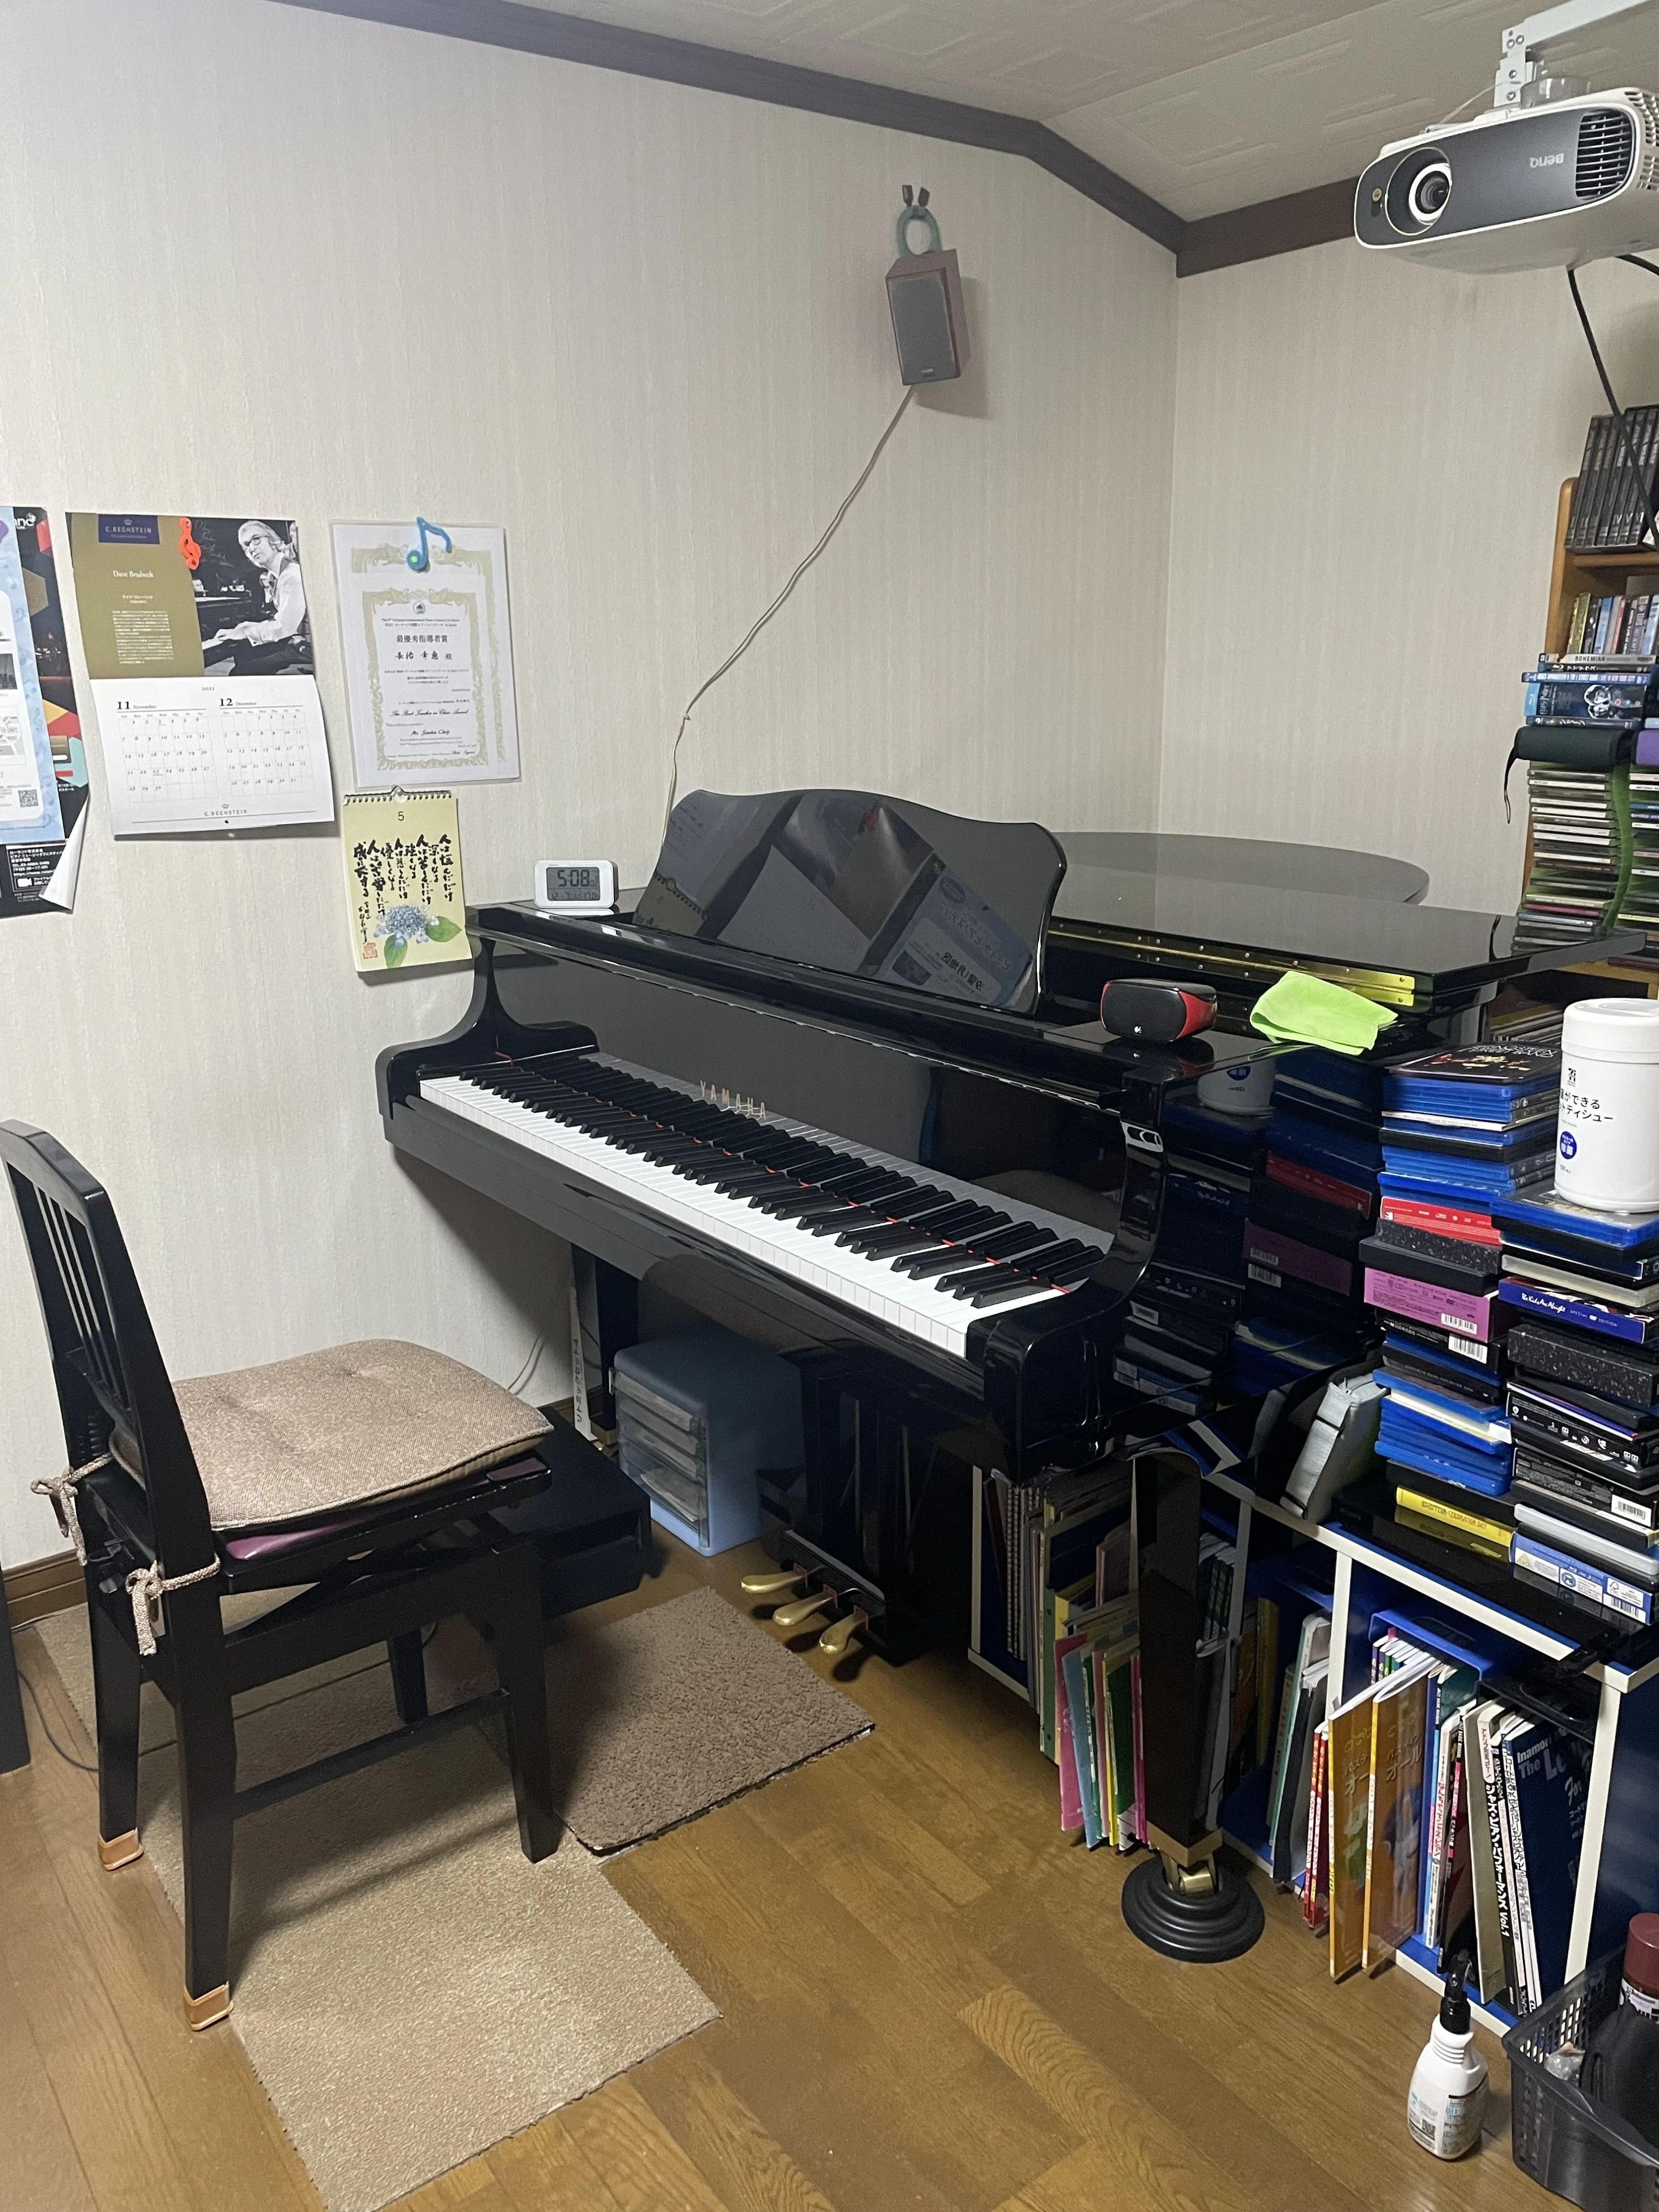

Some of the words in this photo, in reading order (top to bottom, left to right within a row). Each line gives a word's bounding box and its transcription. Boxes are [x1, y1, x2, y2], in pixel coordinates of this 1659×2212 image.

[1529, 153, 1564, 169] BenQ
[397, 635, 448, 643] 最優秀指導者賞
[117, 701, 131, 710] 11
[398, 811, 404, 821] 5
[557, 869, 589, 887] 5:08
[700, 1080, 766, 1120] YAMAHA
[1570, 1310, 1588, 1318] SPECIAL
[1598, 1318, 1618, 1327] EDITION
[1517, 1737, 1552, 1764] Inamori
[1519, 1759, 1541, 1779] The
[1485, 1784, 1507, 1910] ジャズ・ピアノ・パフォーマンス
[1499, 1910, 1510, 1937] Vol.1
